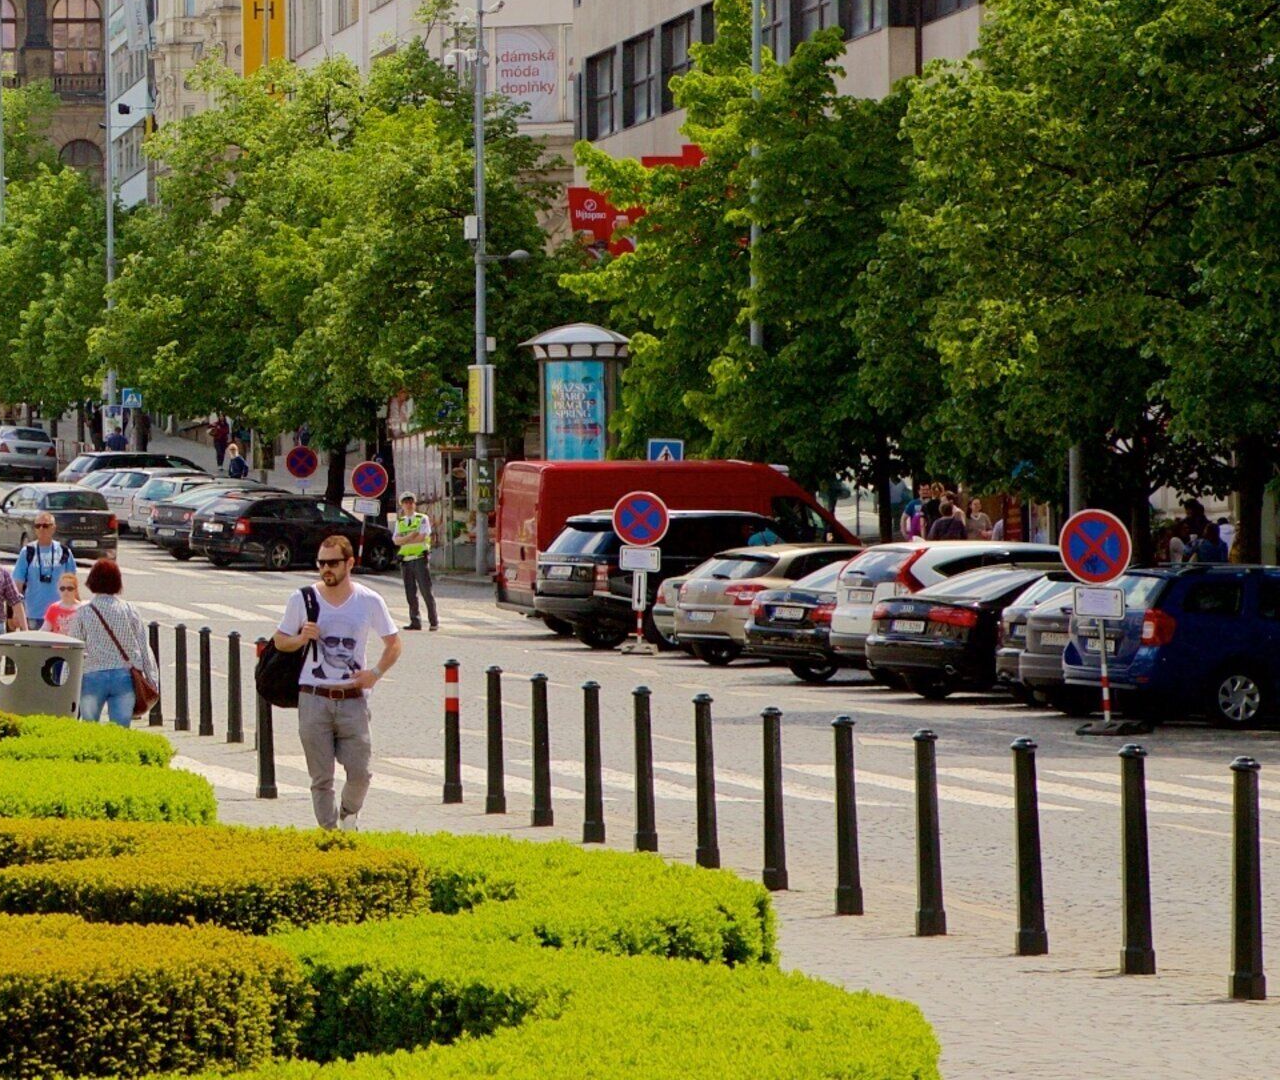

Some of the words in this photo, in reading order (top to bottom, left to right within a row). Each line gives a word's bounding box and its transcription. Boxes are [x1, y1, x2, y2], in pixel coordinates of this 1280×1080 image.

[500, 48, 555, 63] dámská
[500, 65, 540, 77] móda
[500, 81, 555, 95] doplňky
